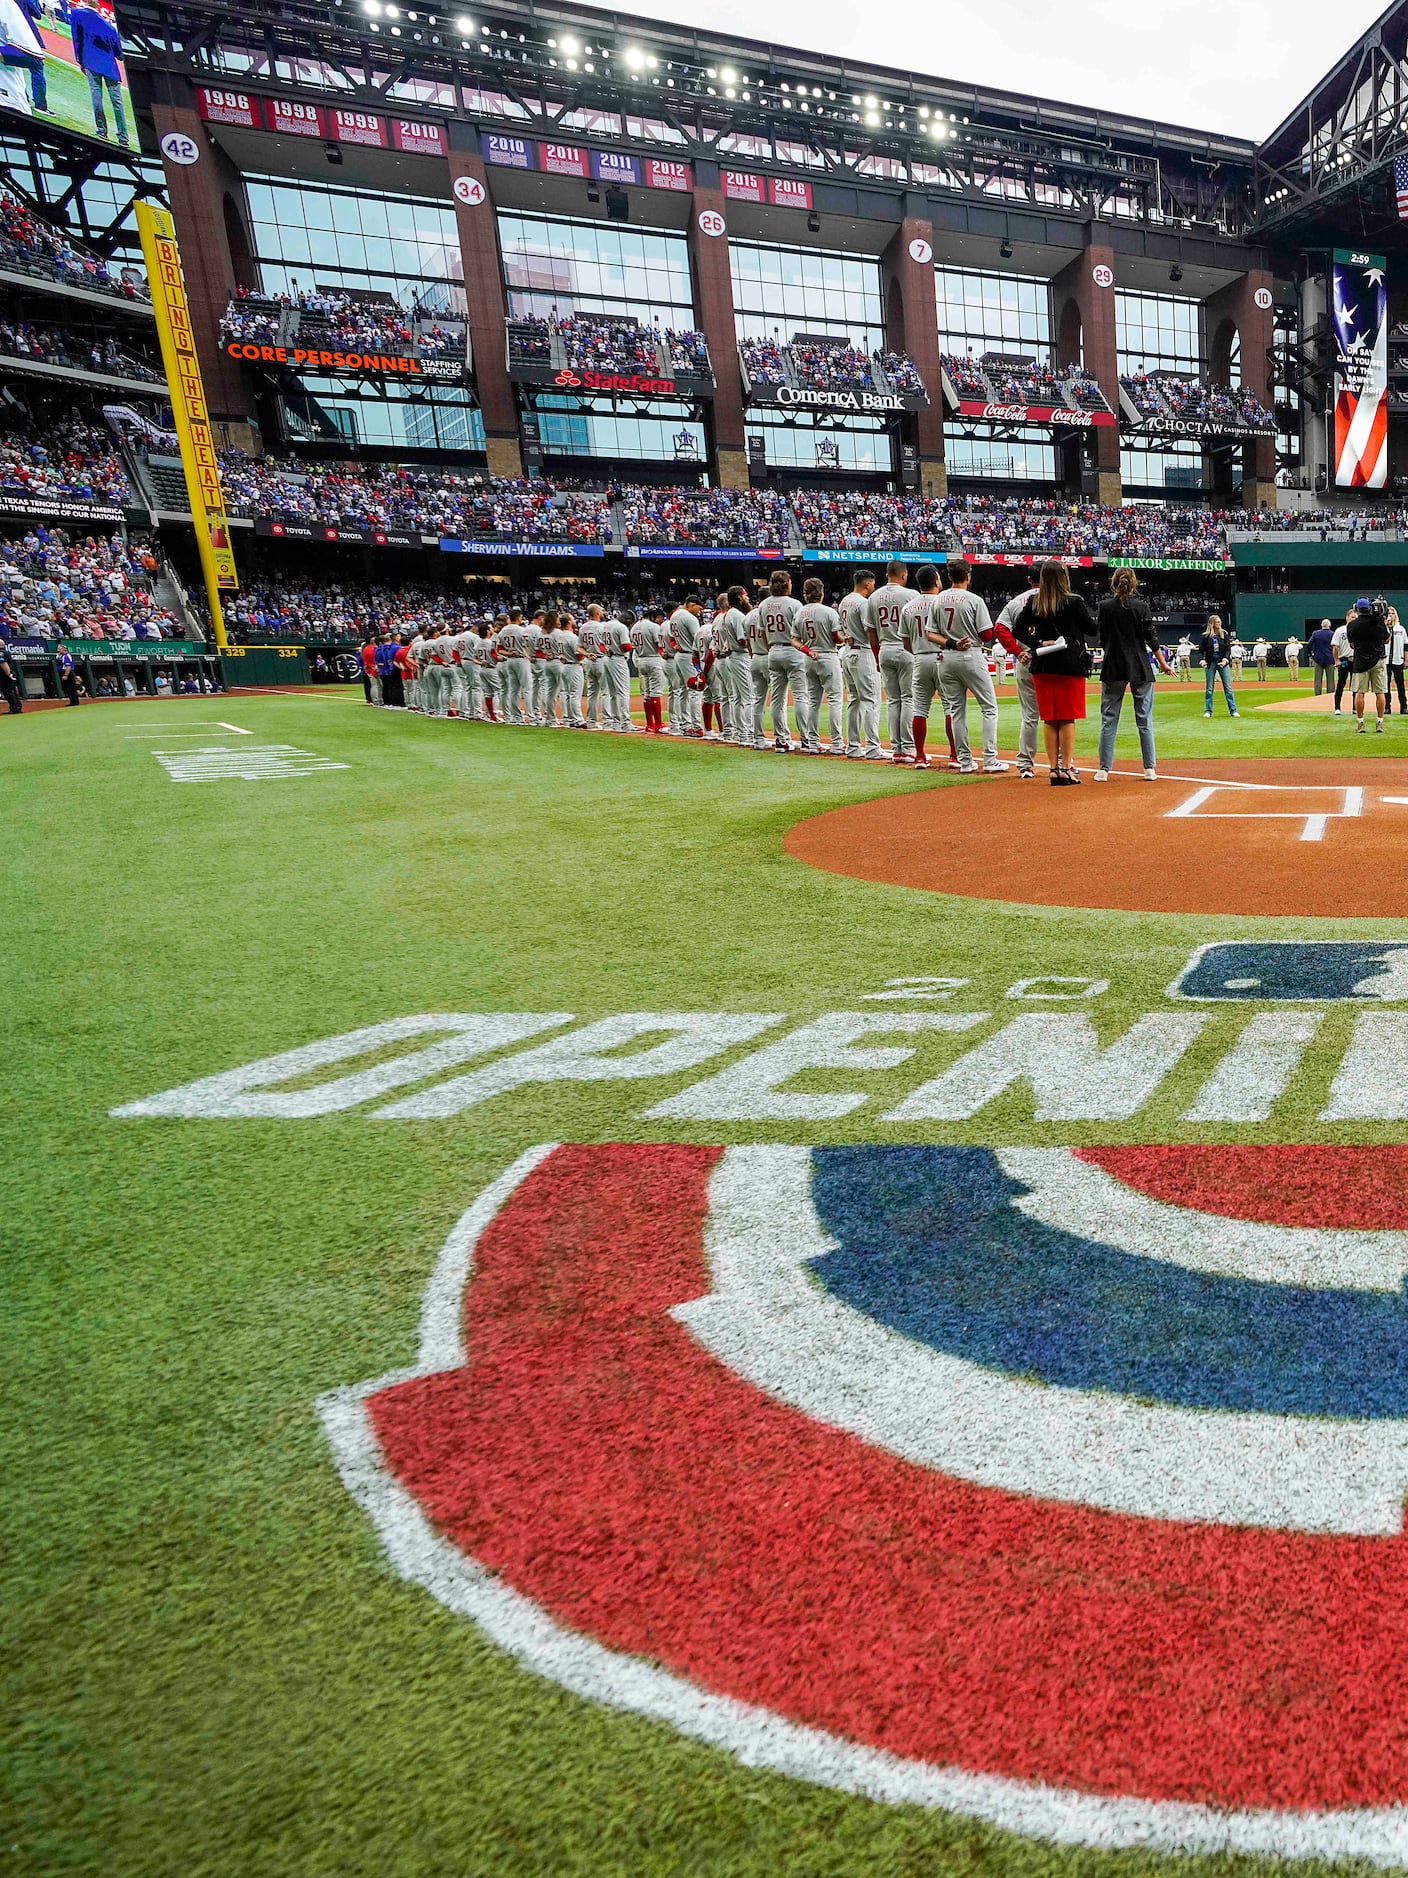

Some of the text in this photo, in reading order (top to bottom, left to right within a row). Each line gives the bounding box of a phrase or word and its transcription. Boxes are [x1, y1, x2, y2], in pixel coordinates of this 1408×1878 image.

[203, 88, 249, 110] 1996
[272, 100, 317, 121] 1998
[336, 110, 379, 130] 1999
[400, 121, 438, 139] 2010
[167, 139, 194, 159] 42
[488, 136, 525, 153] 2010
[547, 145, 580, 161] 2011
[600, 153, 632, 169] 2011
[652, 161, 685, 177] 2012
[727, 172, 757, 188] 2015
[459, 182, 481, 200] 34
[775, 179, 805, 195] 2016
[703, 215, 722, 231] 26
[917, 244, 925, 257] 7
[1351, 254, 1369, 265] 2:59
[1095, 269, 1111, 282] 29
[1258, 292, 1268, 305] 10
[228, 344, 422, 373] CORE PERSONNEL
[420, 359, 462, 369] STAFFING
[1337, 356, 1353, 364] CAN
[1354, 357, 1370, 365] YOU
[160, 242, 215, 505] BRING THE HEAT
[422, 367, 463, 377] SERVICES
[1348, 366, 1358, 374] BY
[1339, 384, 1360, 393] EARLY
[862, 393, 906, 410] Bank
[1154, 416, 1223, 435] CHOCTAW
[3, 497, 124, 515] TEXAS TENORS HONOR AMERICA
[9, 505, 127, 522] THE SINGING OF OUR NATIONAL
[285, 527, 312, 536] TOYOTA
[338, 532, 363, 541] TOYOTA
[387, 536, 410, 545] TOYOTA
[832, 549, 894, 561] NETSPEND
[974, 553, 996, 561] DEX
[1004, 554, 1025, 562] DEX
[1061, 555, 1081, 563] DEX
[1120, 558, 1223, 571] LUXOR STAFFING
[879, 593, 897, 603] HALL
[766, 614, 786, 633] 28
[878, 606, 900, 628] 24
[945, 607, 955, 631] 7
[806, 620, 817, 640] 5
[504, 636, 516, 647] 37
[539, 637, 551, 649] 25
[583, 632, 594, 646] 45
[633, 633, 643, 646] 30
[8, 643, 45, 654] Germania
[278, 649, 297, 657] 334
[439, 644, 445, 654] 3
[478, 649, 487, 660] 21
